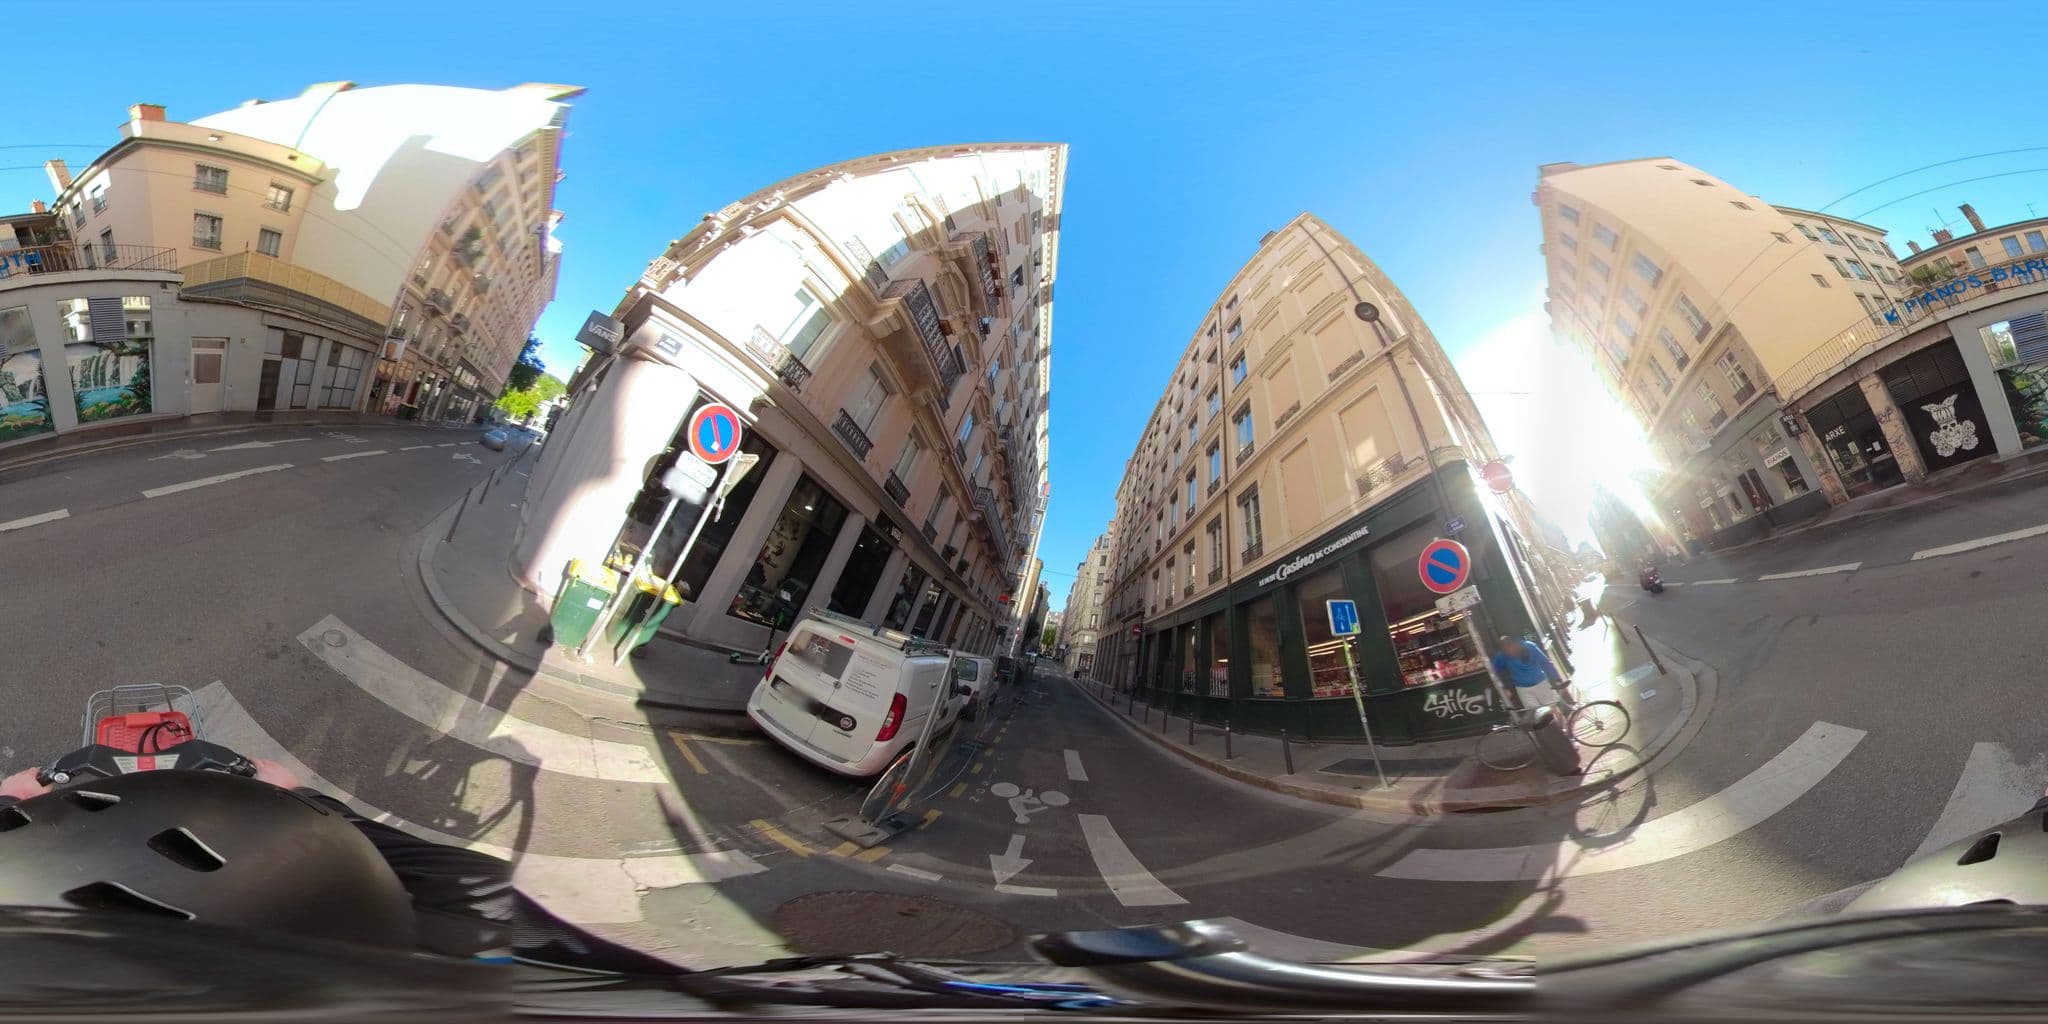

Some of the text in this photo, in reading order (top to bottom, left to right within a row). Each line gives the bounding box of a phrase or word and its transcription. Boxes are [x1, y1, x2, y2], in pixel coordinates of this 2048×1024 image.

[1903, 273, 1983, 313] PIANOS
[588, 321, 619, 343] VANS
[1824, 425, 1846, 442] ARXE
[1275, 553, 1316, 581] Casino
[1323, 525, 1370, 555] CONSTANTINE
